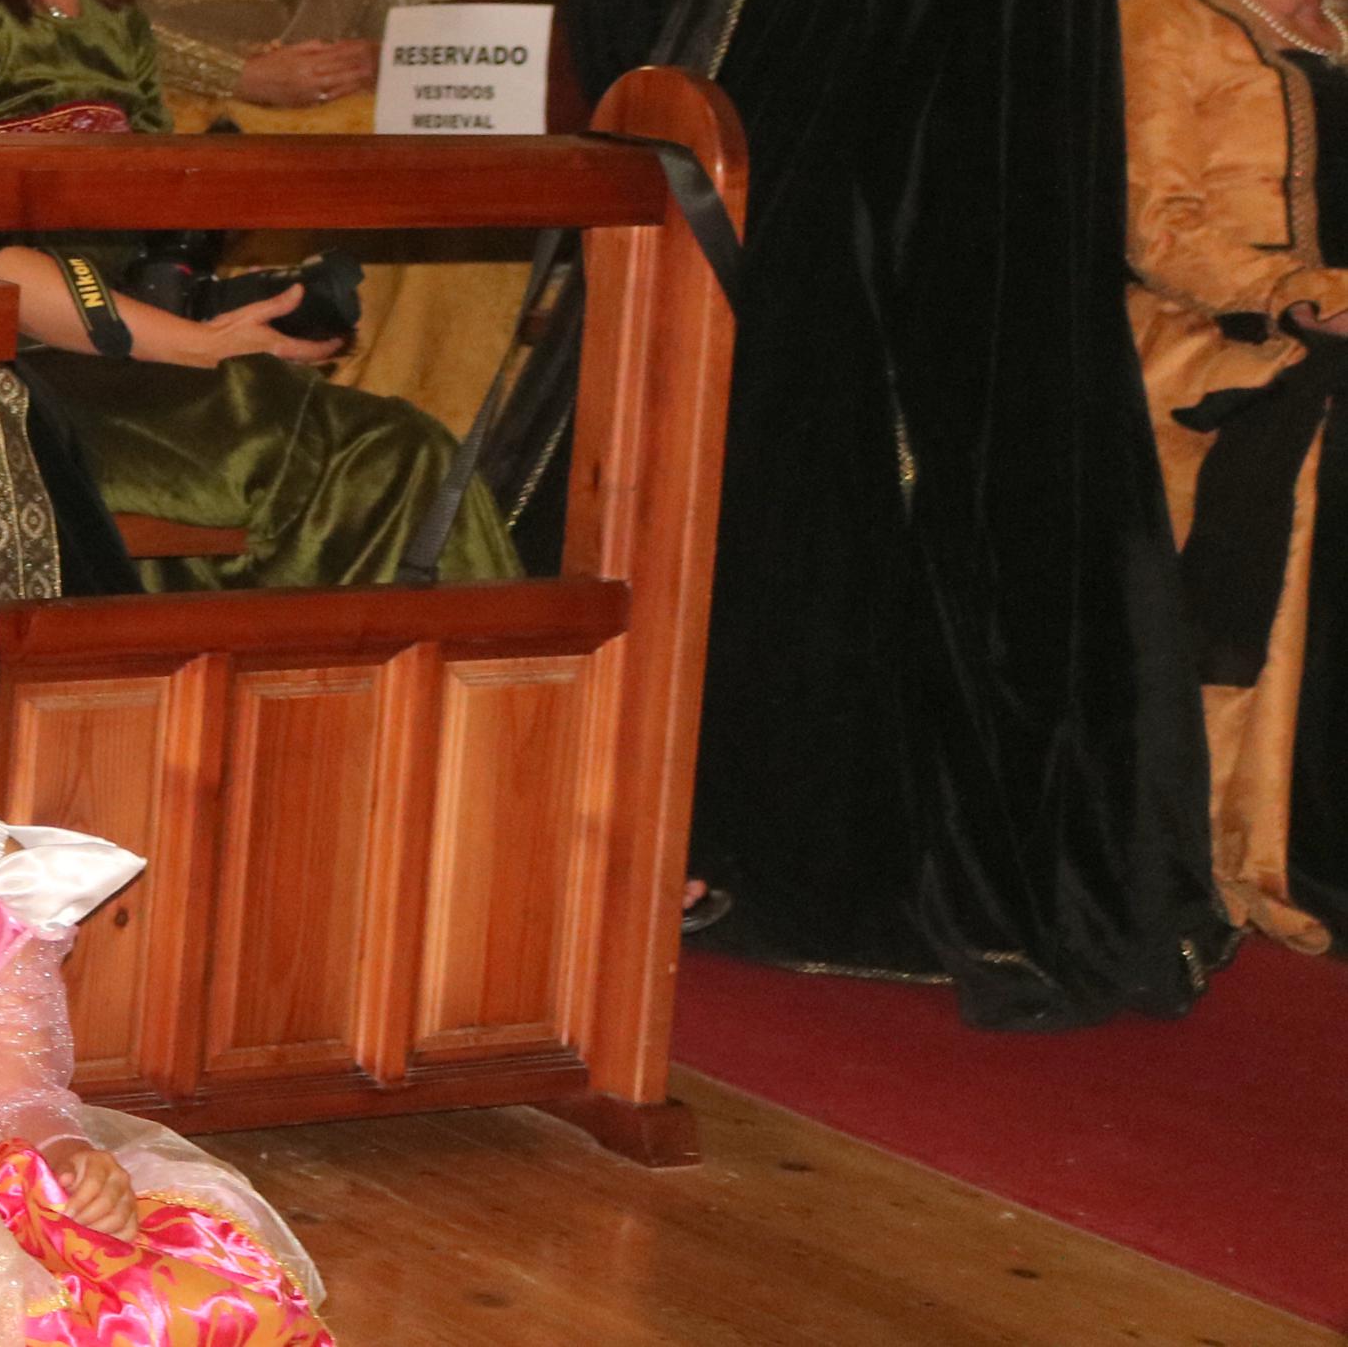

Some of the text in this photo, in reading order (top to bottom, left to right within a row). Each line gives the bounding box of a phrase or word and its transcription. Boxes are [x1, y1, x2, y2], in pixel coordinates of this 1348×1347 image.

[393, 45, 528, 66] RESERVADO
[414, 85, 495, 100] VESTIDOS
[412, 114, 494, 129] MEDIEVAL
[68, 258, 105, 308] Nikon
